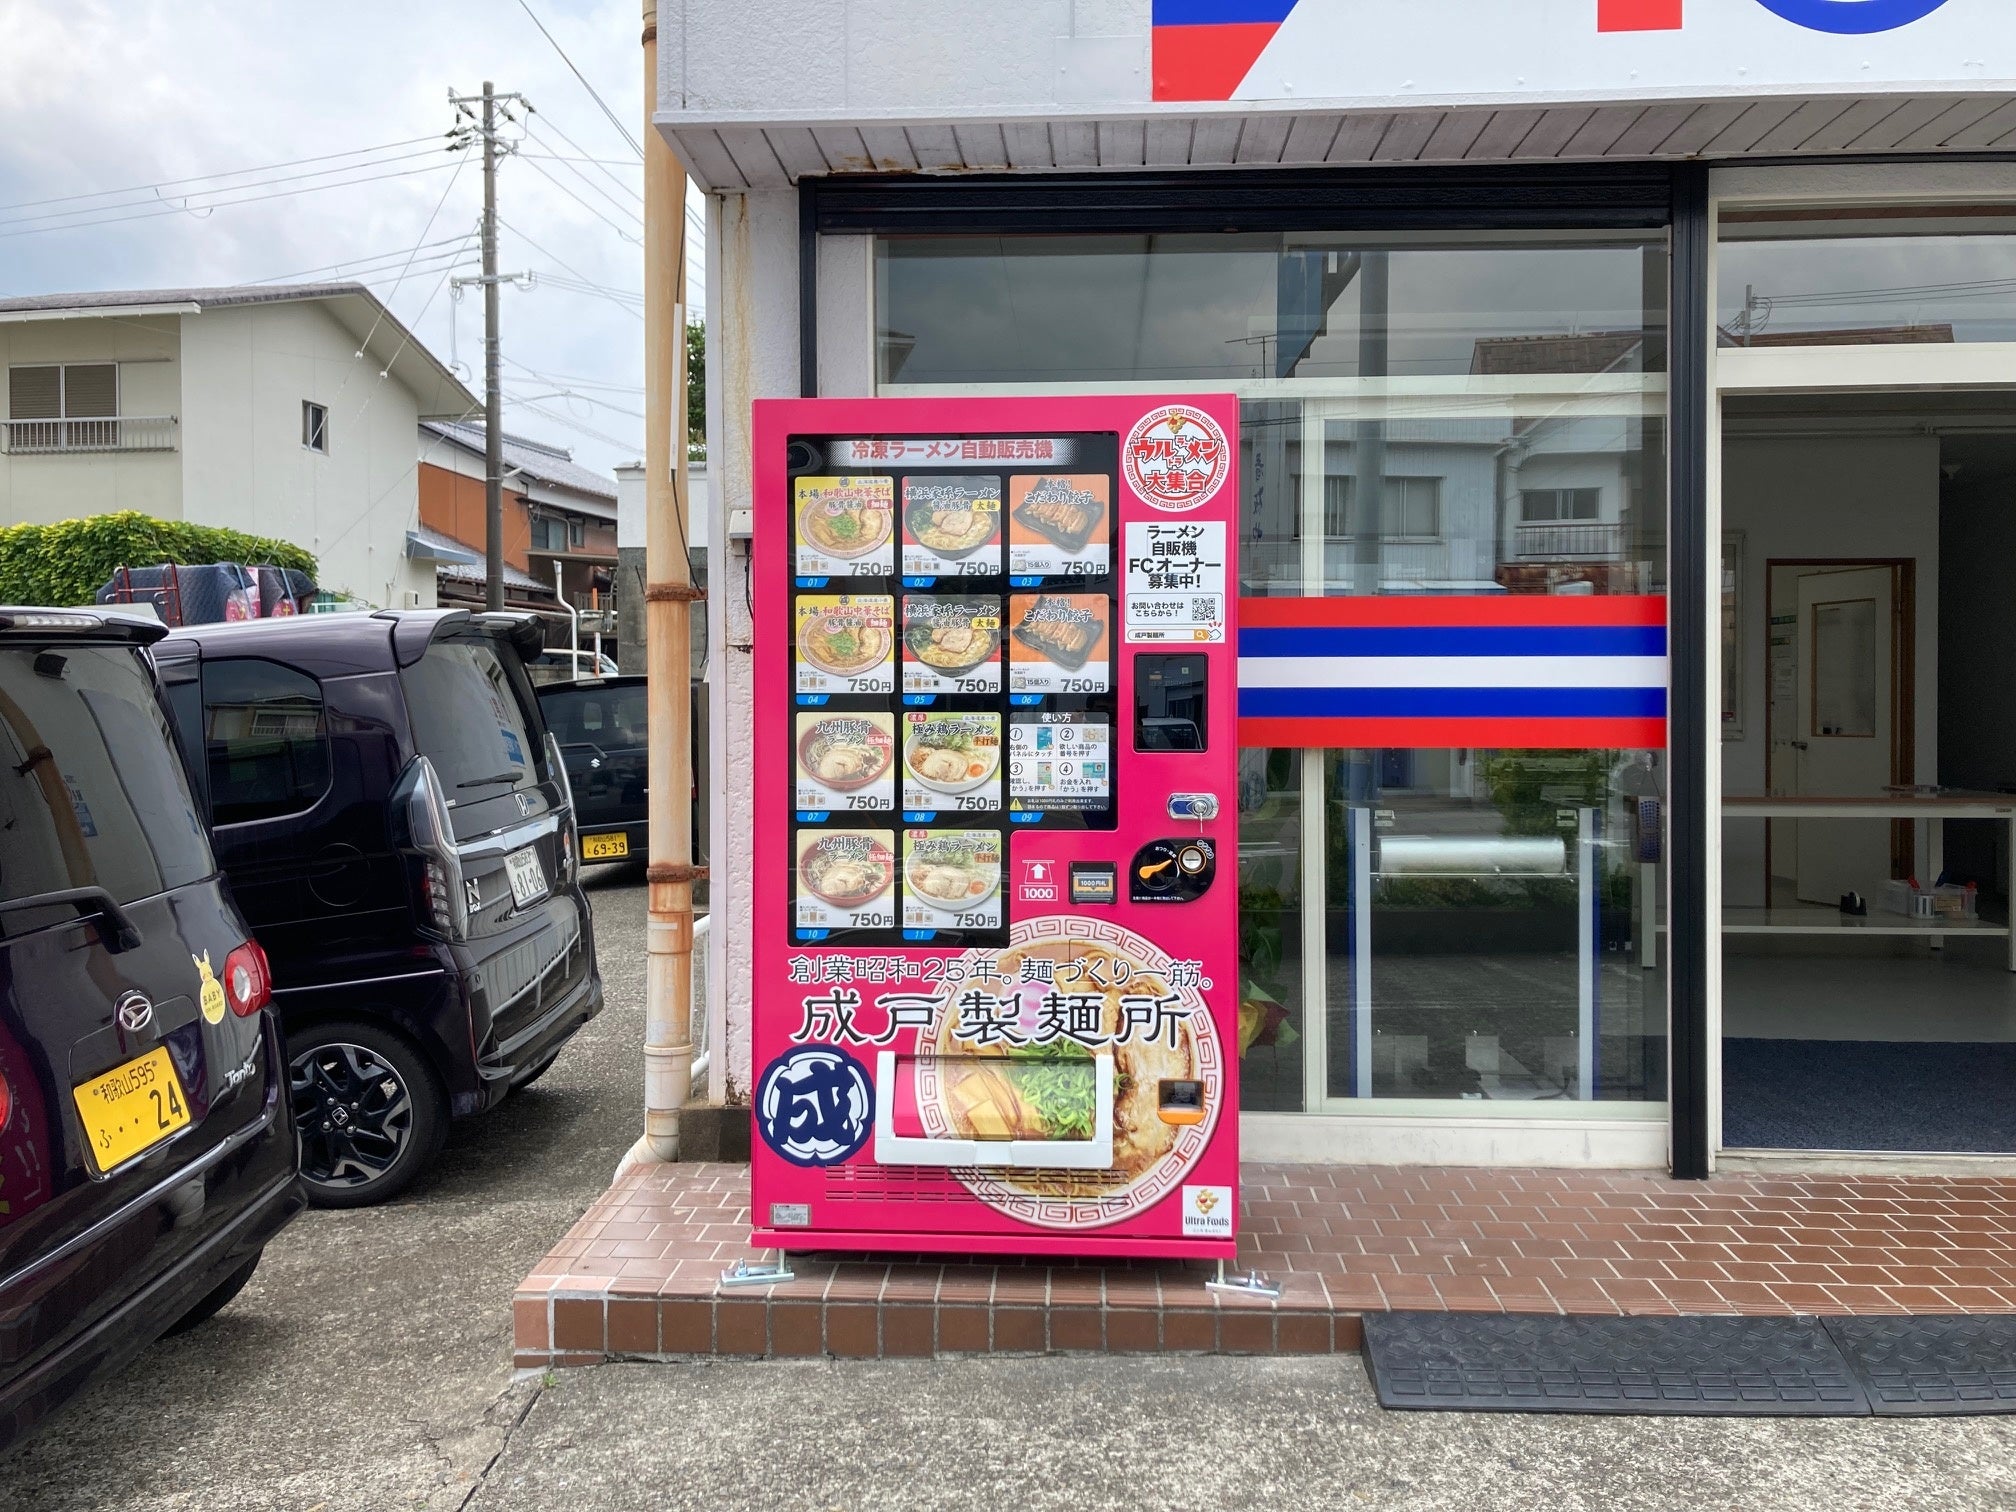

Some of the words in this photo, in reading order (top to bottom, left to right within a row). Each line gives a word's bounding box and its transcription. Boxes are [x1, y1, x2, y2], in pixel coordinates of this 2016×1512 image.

[851, 440, 1053, 459] 冷凍ラーメン自動販売機
[1145, 471, 1207, 492] 大集合
[798, 489, 819, 499] 本場
[822, 487, 891, 498] 和歌山中華そば
[904, 486, 1000, 500] 横浜家系ラーメン
[1025, 490, 1094, 504] こだわり餃子
[977, 501, 996, 510] 太麺
[1147, 525, 1204, 539] ラーメン
[1152, 541, 1197, 556] 自販機
[849, 563, 893, 576] 750円
[956, 562, 999, 575] 750円
[1062, 561, 1106, 574] 750円
[807, 578, 818, 587] 01
[914, 578, 925, 587] 02
[1021, 578, 1032, 586] 03
[1148, 573, 1200, 589] 募集中!
[799, 607, 819, 616] 本場
[823, 606, 890, 616] 和歌山中華そば
[904, 604, 1000, 617] 横浜家系ラーメン
[1024, 608, 1093, 622] こだわり餃子
[977, 619, 996, 627] 太麺
[847, 679, 891, 692] 750円
[955, 679, 999, 692] 750円
[1060, 679, 1105, 692] 750円
[807, 696, 819, 704] 04
[914, 696, 925, 704] 05
[1021, 696, 1032, 704] 06
[1041, 712, 1072, 723] 使い方
[816, 720, 872, 734] 九州豚骨
[828, 735, 864, 745] ラーメン
[846, 796, 890, 809] 750円
[955, 796, 999, 810] 750円
[807, 813, 818, 821] 07
[914, 813, 925, 821] 08
[1021, 813, 1033, 822] 09
[594, 842, 625, 855] 69-39
[817, 836, 874, 851] 九州豚骨
[829, 852, 867, 862] ラーメン
[1024, 888, 1053, 898] 1000
[849, 913, 893, 926] 750円
[954, 913, 997, 927] 750円
[203, 990, 220, 1005] BABY
[792, 989, 1191, 1048] 成戸製麺所
[225, 1062, 256, 1087] Tanto
[101, 1061, 155, 1104] 和歌山595
[100, 1129, 112, 1148] ふ
[1185, 1216, 1205, 1225] Ultra
[1207, 1216, 1229, 1226] Foods
